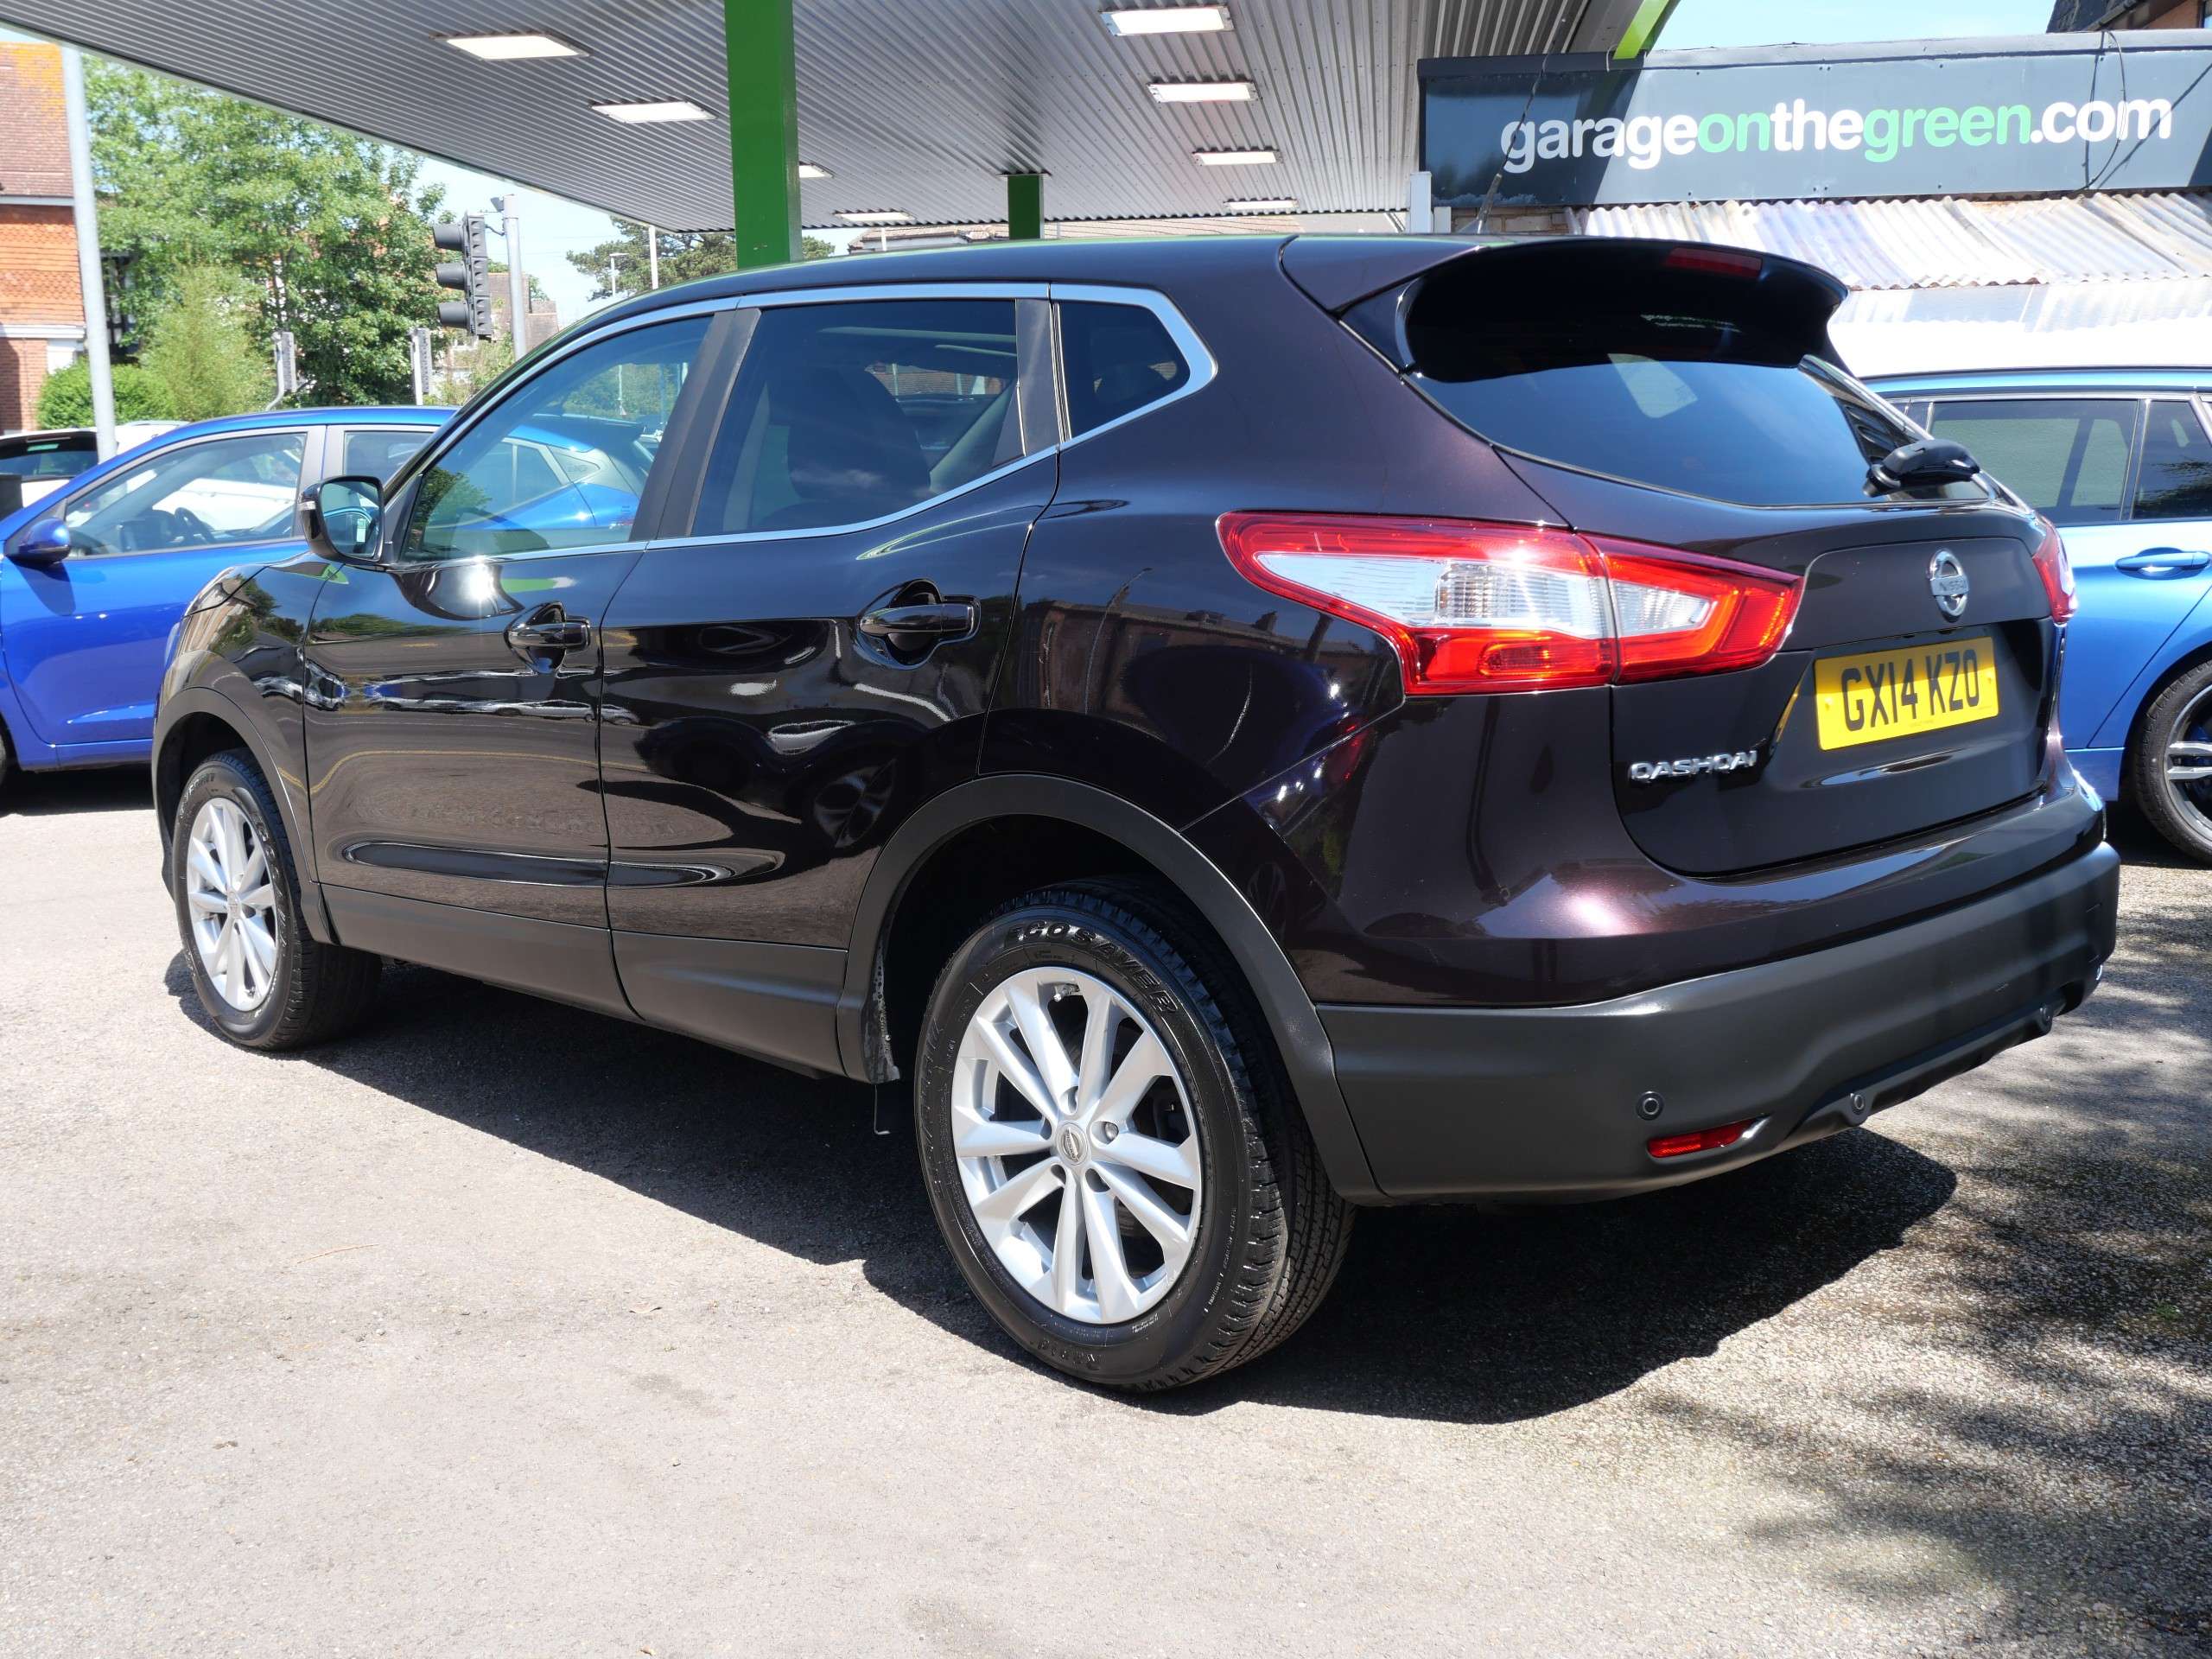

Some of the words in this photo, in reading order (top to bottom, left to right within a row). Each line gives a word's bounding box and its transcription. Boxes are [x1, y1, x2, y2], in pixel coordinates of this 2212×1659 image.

[1502, 99, 2173, 173] garageonthegreen.com
[1841, 658, 1918, 732] GX14
[1925, 649, 1980, 716] KZO
[1630, 750, 1758, 784] QASHQAI
